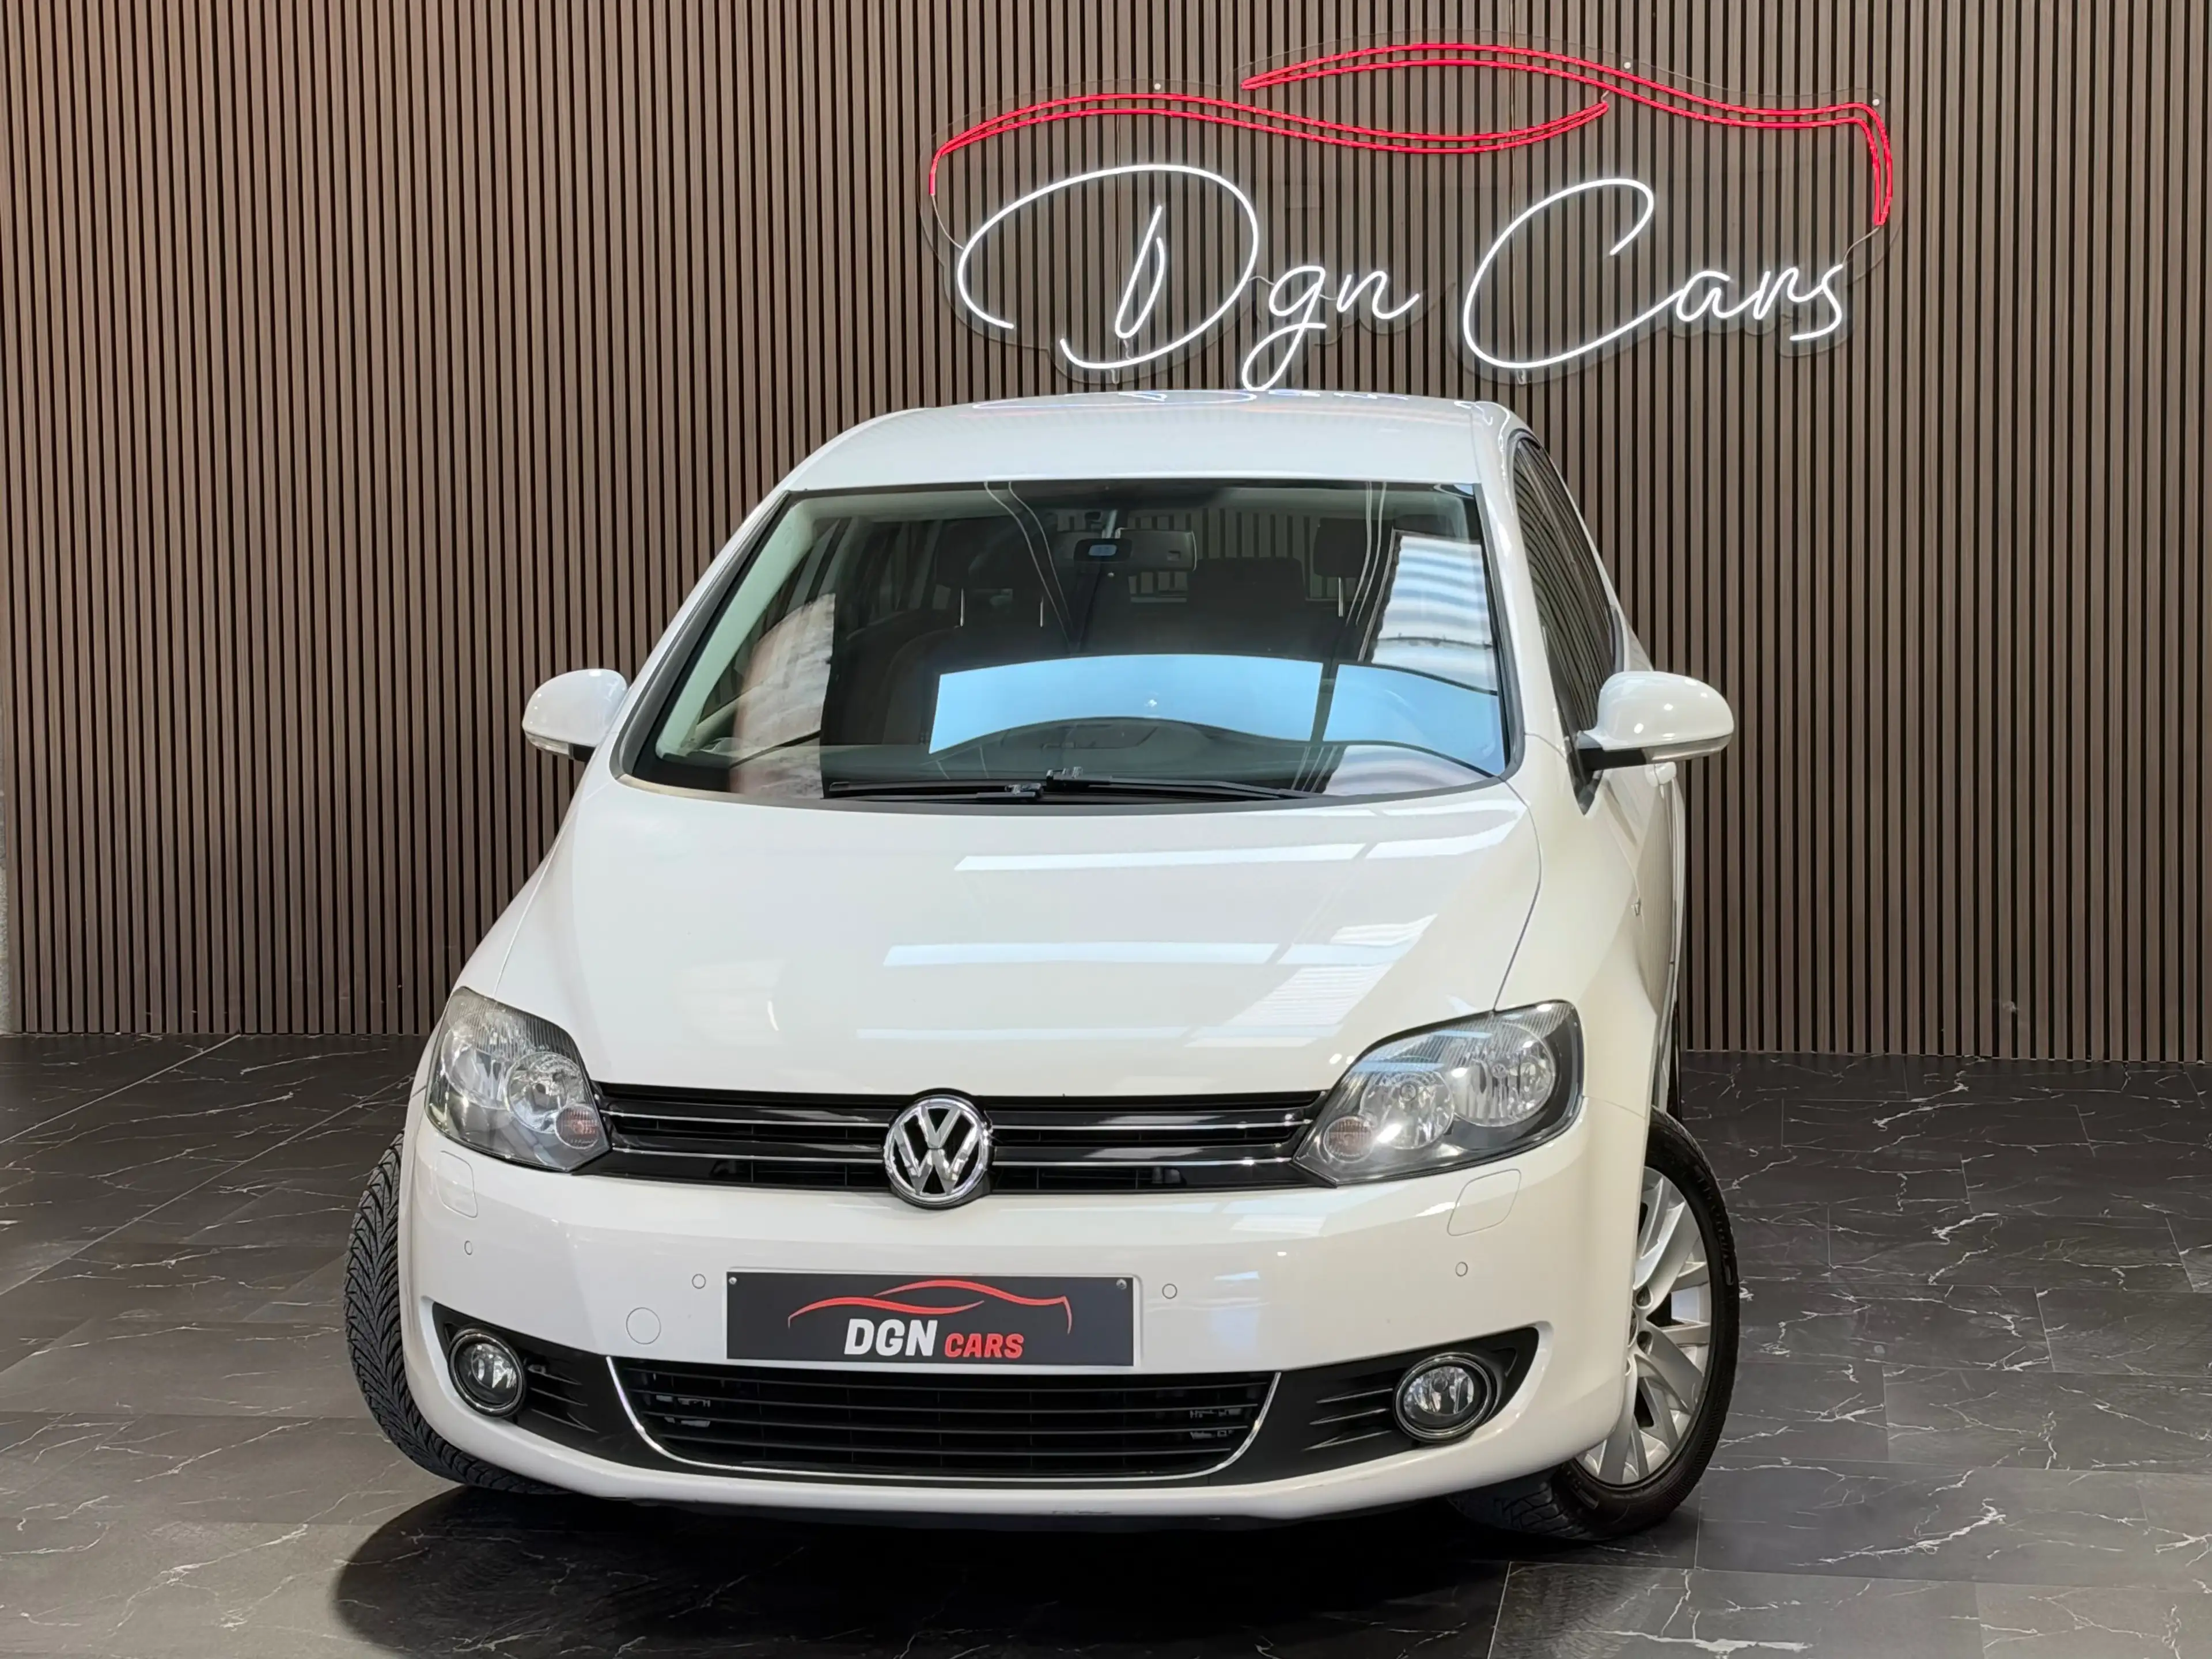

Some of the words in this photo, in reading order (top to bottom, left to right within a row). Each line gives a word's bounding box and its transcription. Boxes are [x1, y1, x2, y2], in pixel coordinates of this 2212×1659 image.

[956, 163, 1421, 391] Dgn
[1462, 177, 1844, 369] Cars
[843, 1318, 938, 1357] DGN
[944, 1332, 1024, 1359] CARS
